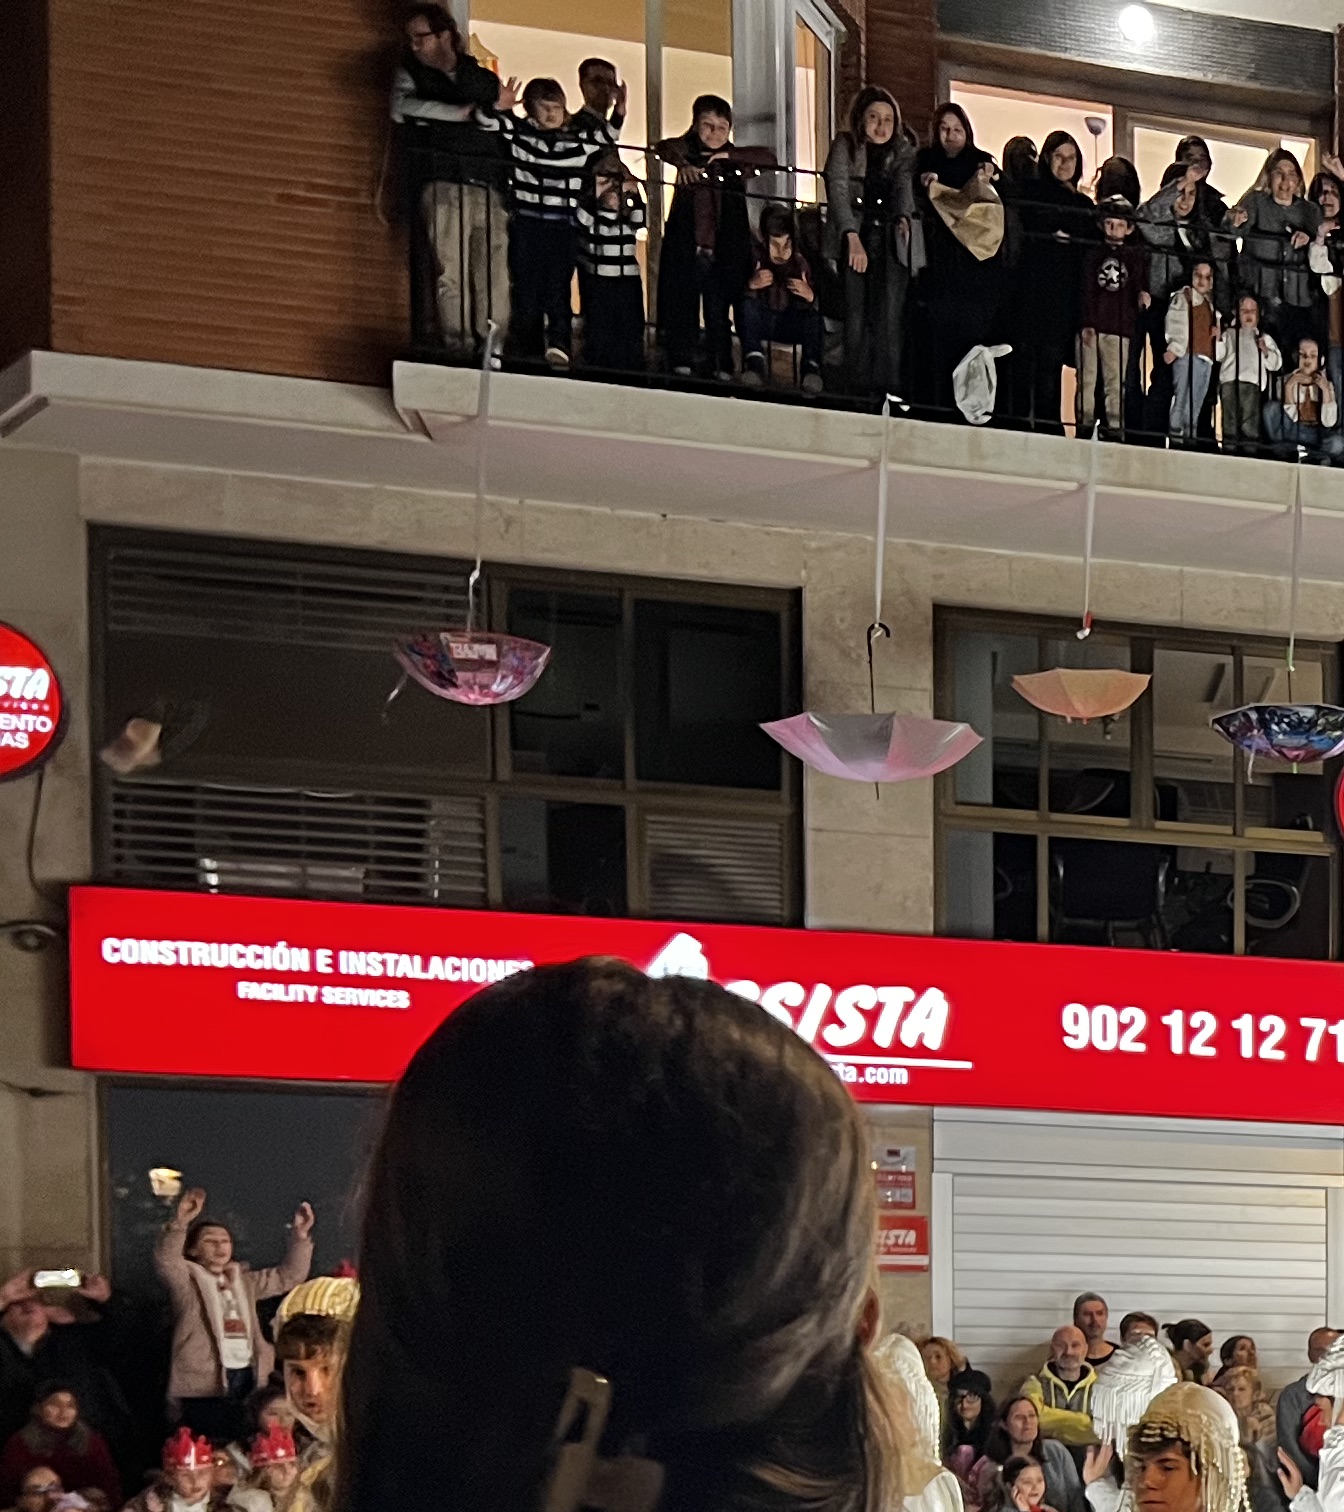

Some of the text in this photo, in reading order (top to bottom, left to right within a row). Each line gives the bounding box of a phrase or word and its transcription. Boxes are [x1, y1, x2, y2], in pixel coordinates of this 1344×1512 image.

[101, 936, 311, 973] CONSTRUCCIÓN
[315, 947, 334, 974] E
[237, 980, 411, 1009] FACILITY SERVICES
[1061, 1002, 1147, 1053] 902
[1160, 1009, 1218, 1058] 12
[1230, 1013, 1287, 1061] 12
[831, 1062, 909, 1085] ta.com
